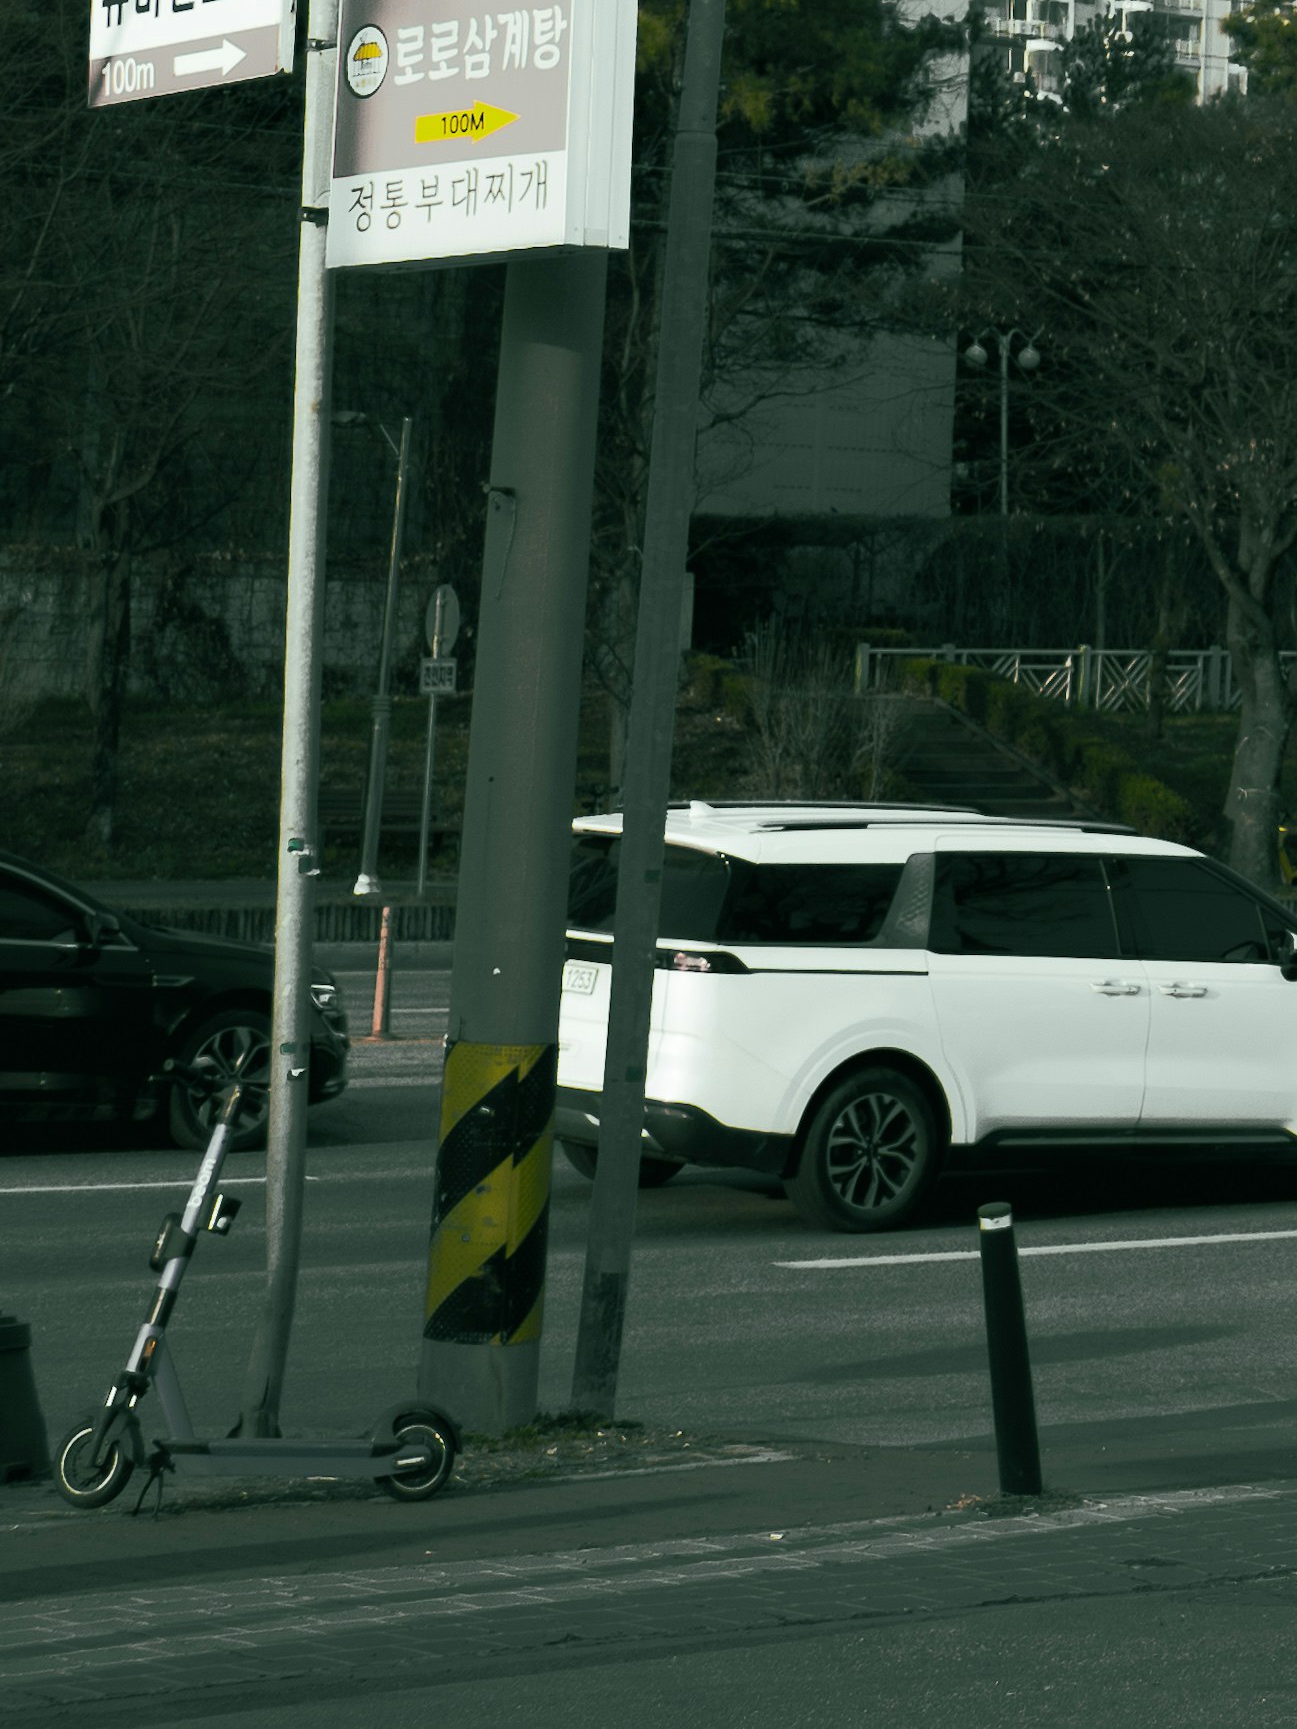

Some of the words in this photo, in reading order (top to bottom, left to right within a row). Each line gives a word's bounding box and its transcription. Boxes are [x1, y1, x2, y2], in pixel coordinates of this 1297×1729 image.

[393, 4, 568, 86] 로로삼계탕
[102, 57, 155, 96] 100m
[441, 112, 485, 135] 100M
